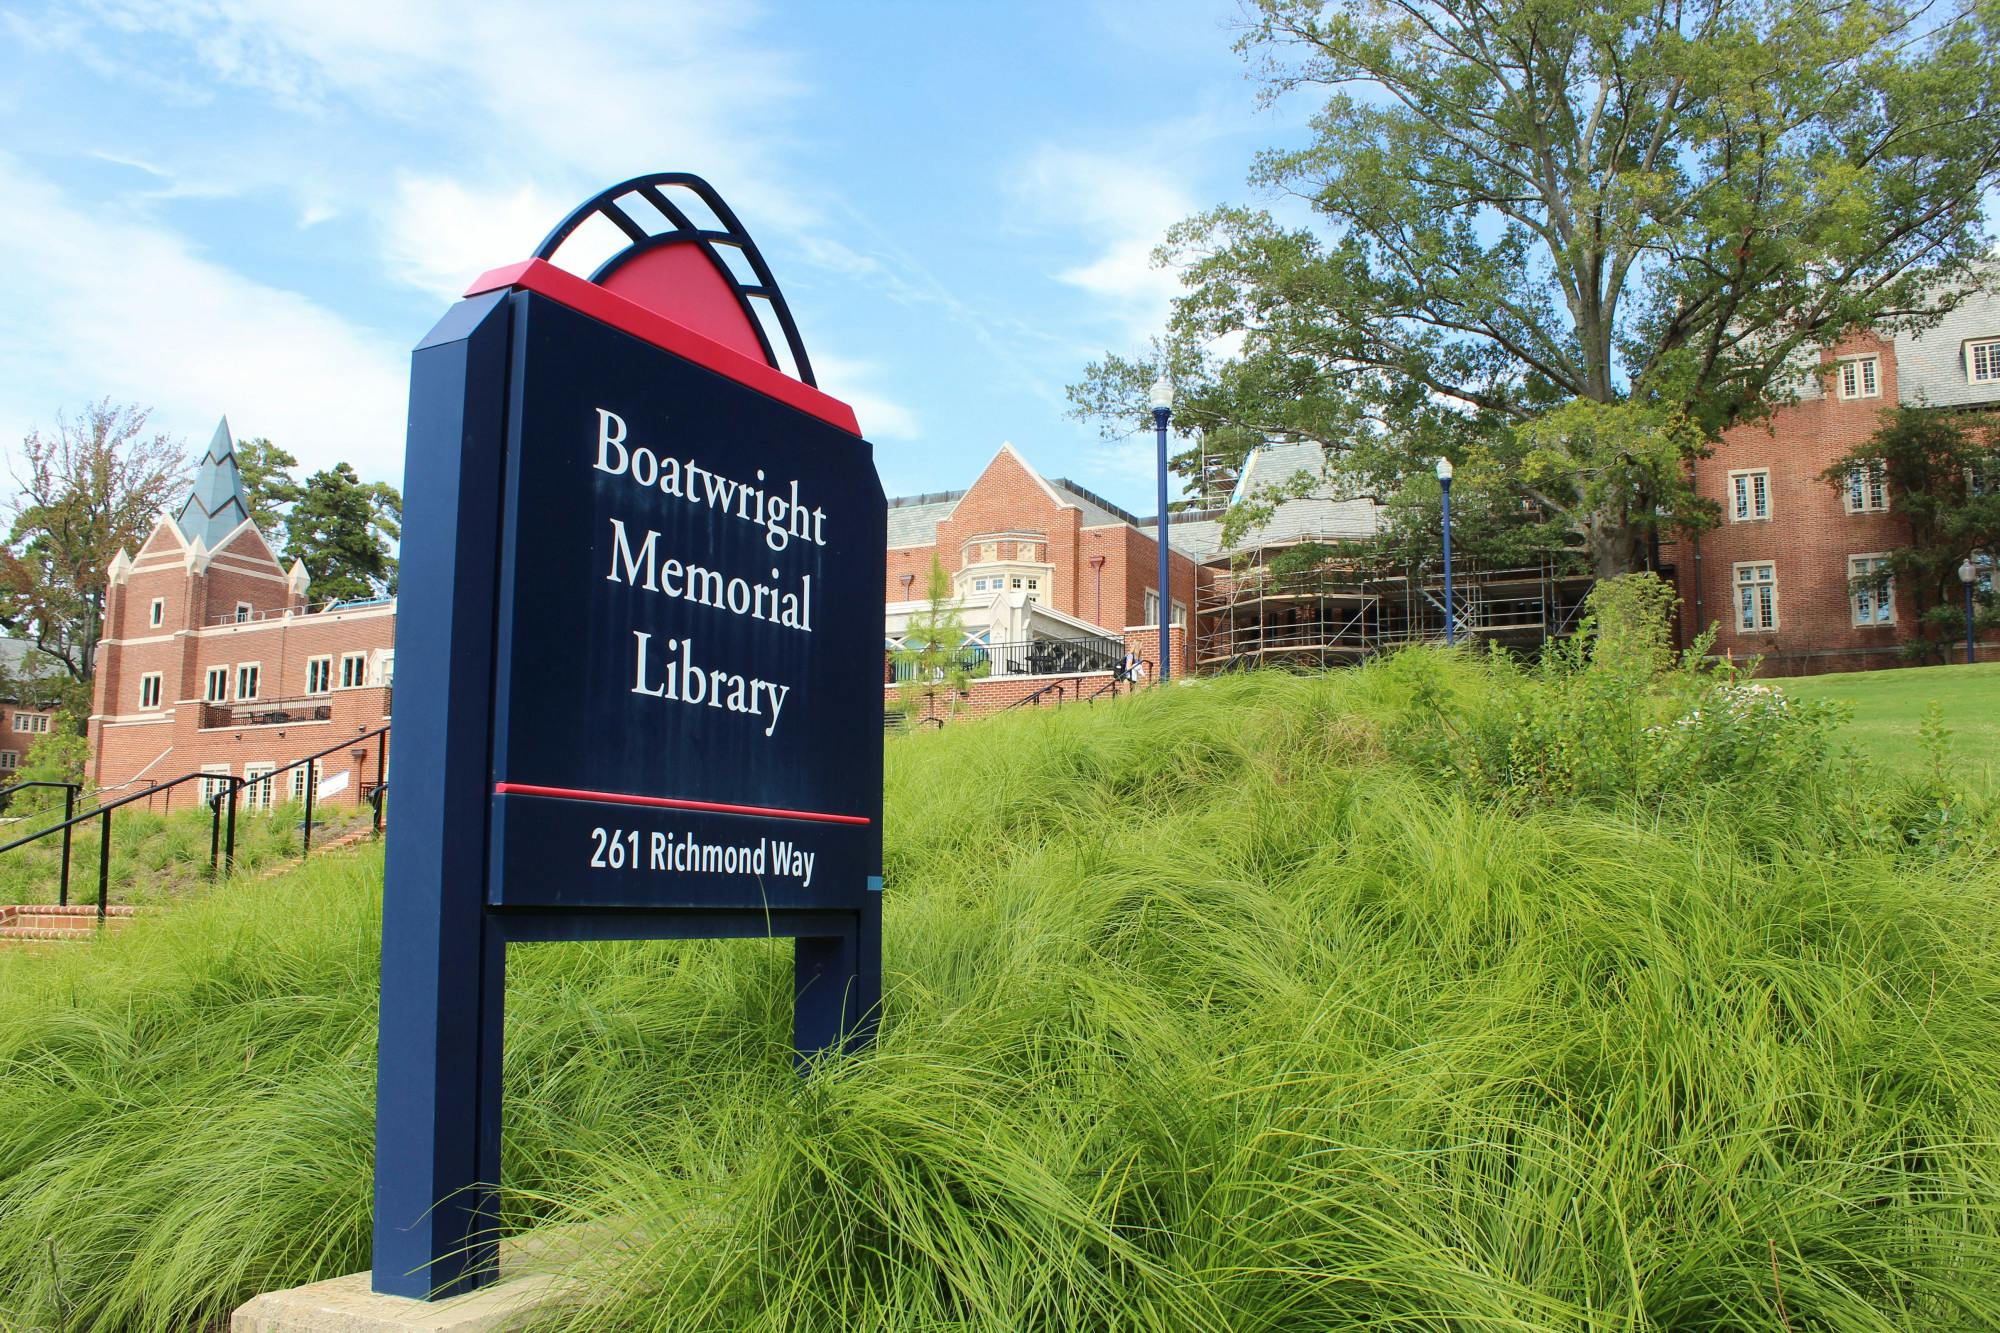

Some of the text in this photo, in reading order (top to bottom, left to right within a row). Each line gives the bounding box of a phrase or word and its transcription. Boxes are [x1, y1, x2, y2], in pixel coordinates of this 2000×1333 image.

[592, 407, 827, 552] Boatwright
[606, 517, 812, 632] Memorial
[631, 630, 790, 737] Library
[590, 827, 815, 888] 261 Richmond Way
